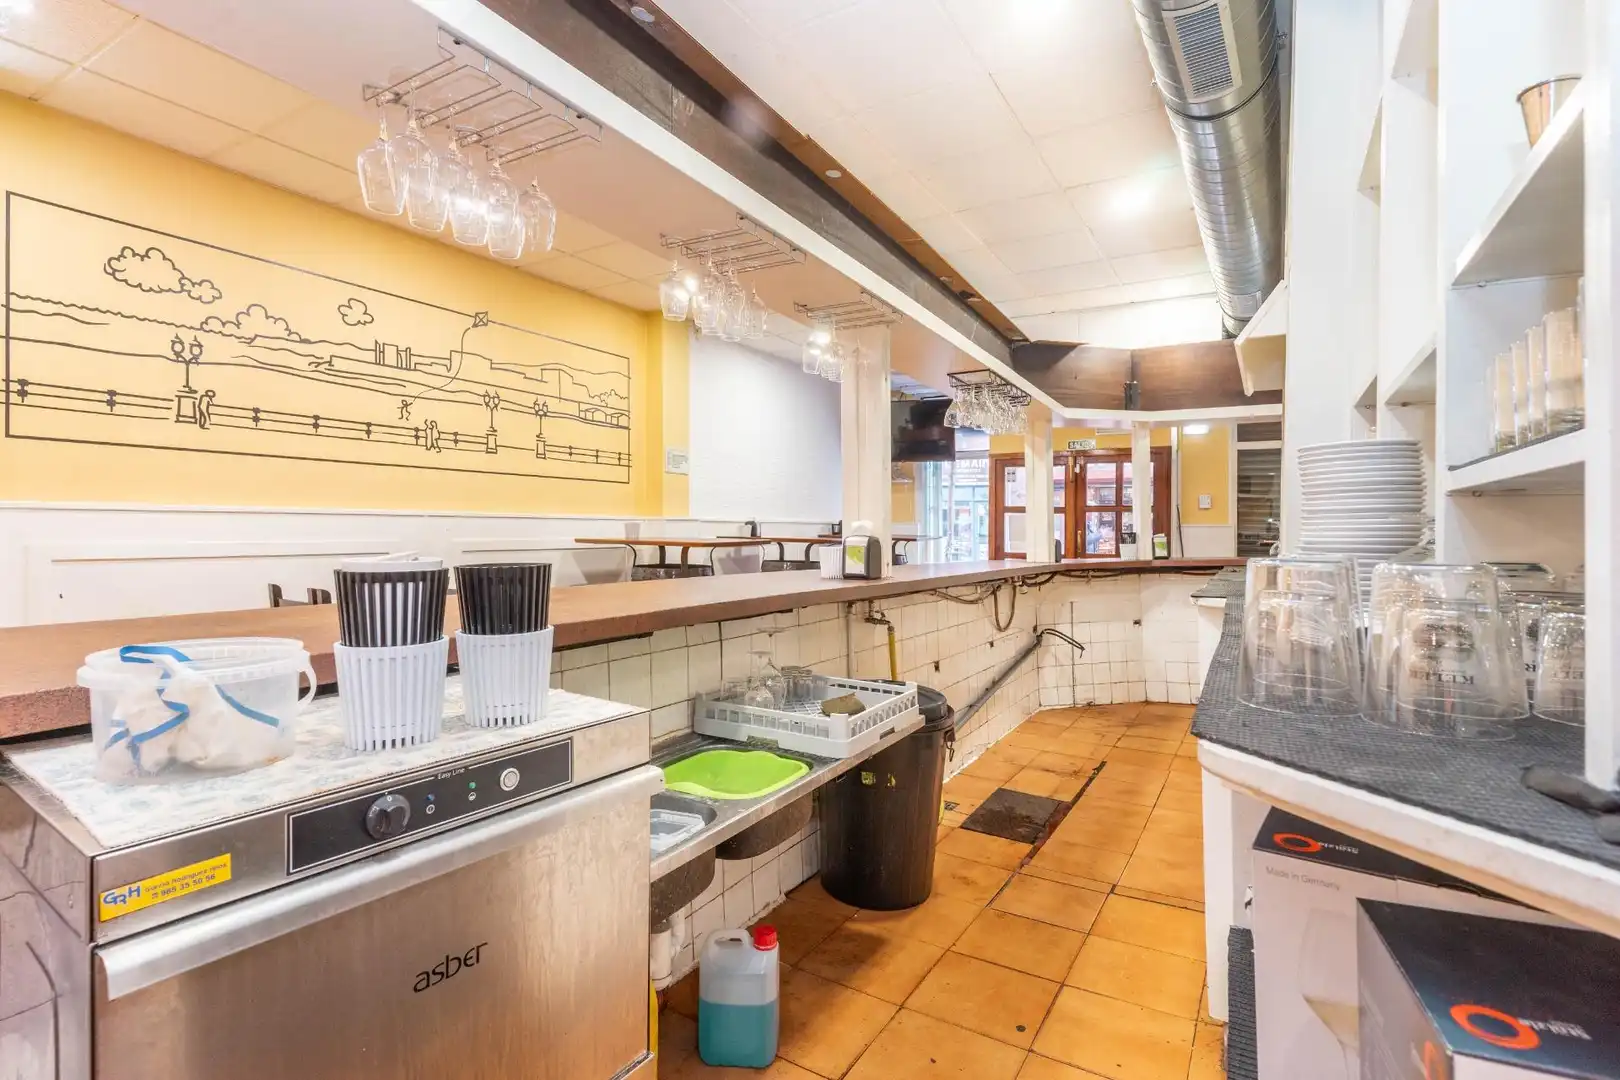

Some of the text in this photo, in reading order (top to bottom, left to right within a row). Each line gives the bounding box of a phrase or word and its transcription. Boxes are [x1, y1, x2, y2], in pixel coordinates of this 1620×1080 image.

[437, 767, 466, 780] Easy Line
[192, 877, 203, 886] 50
[206, 873, 216, 882] 56
[1265, 866, 1340, 891] Made in Germany
[103, 885, 141, 905] GRH
[413, 942, 488, 993] asber
